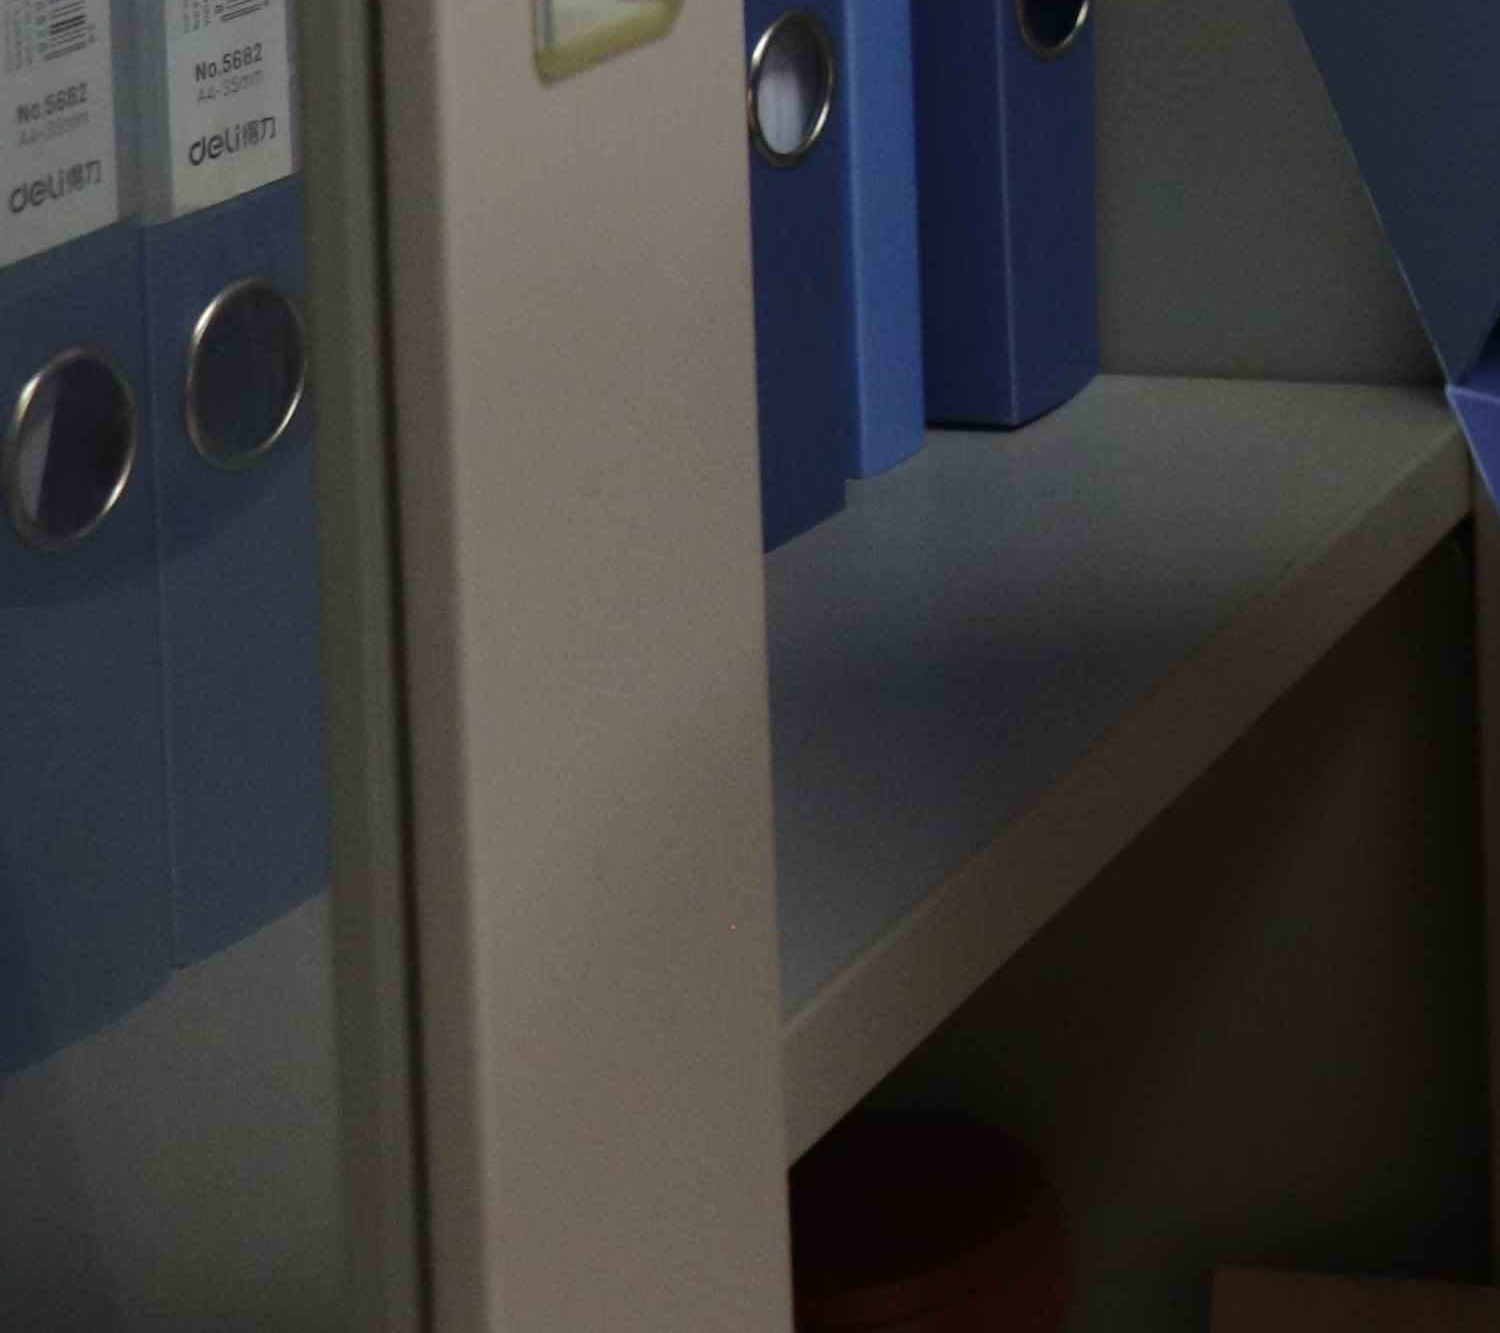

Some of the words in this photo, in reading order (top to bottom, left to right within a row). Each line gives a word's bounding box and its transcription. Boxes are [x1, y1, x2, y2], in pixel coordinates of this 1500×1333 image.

[194, 41, 263, 82] No.5682
[16, 82, 88, 126] No.5682
[189, 115, 276, 167] deli得力
[9, 159, 101, 214] deli得力
